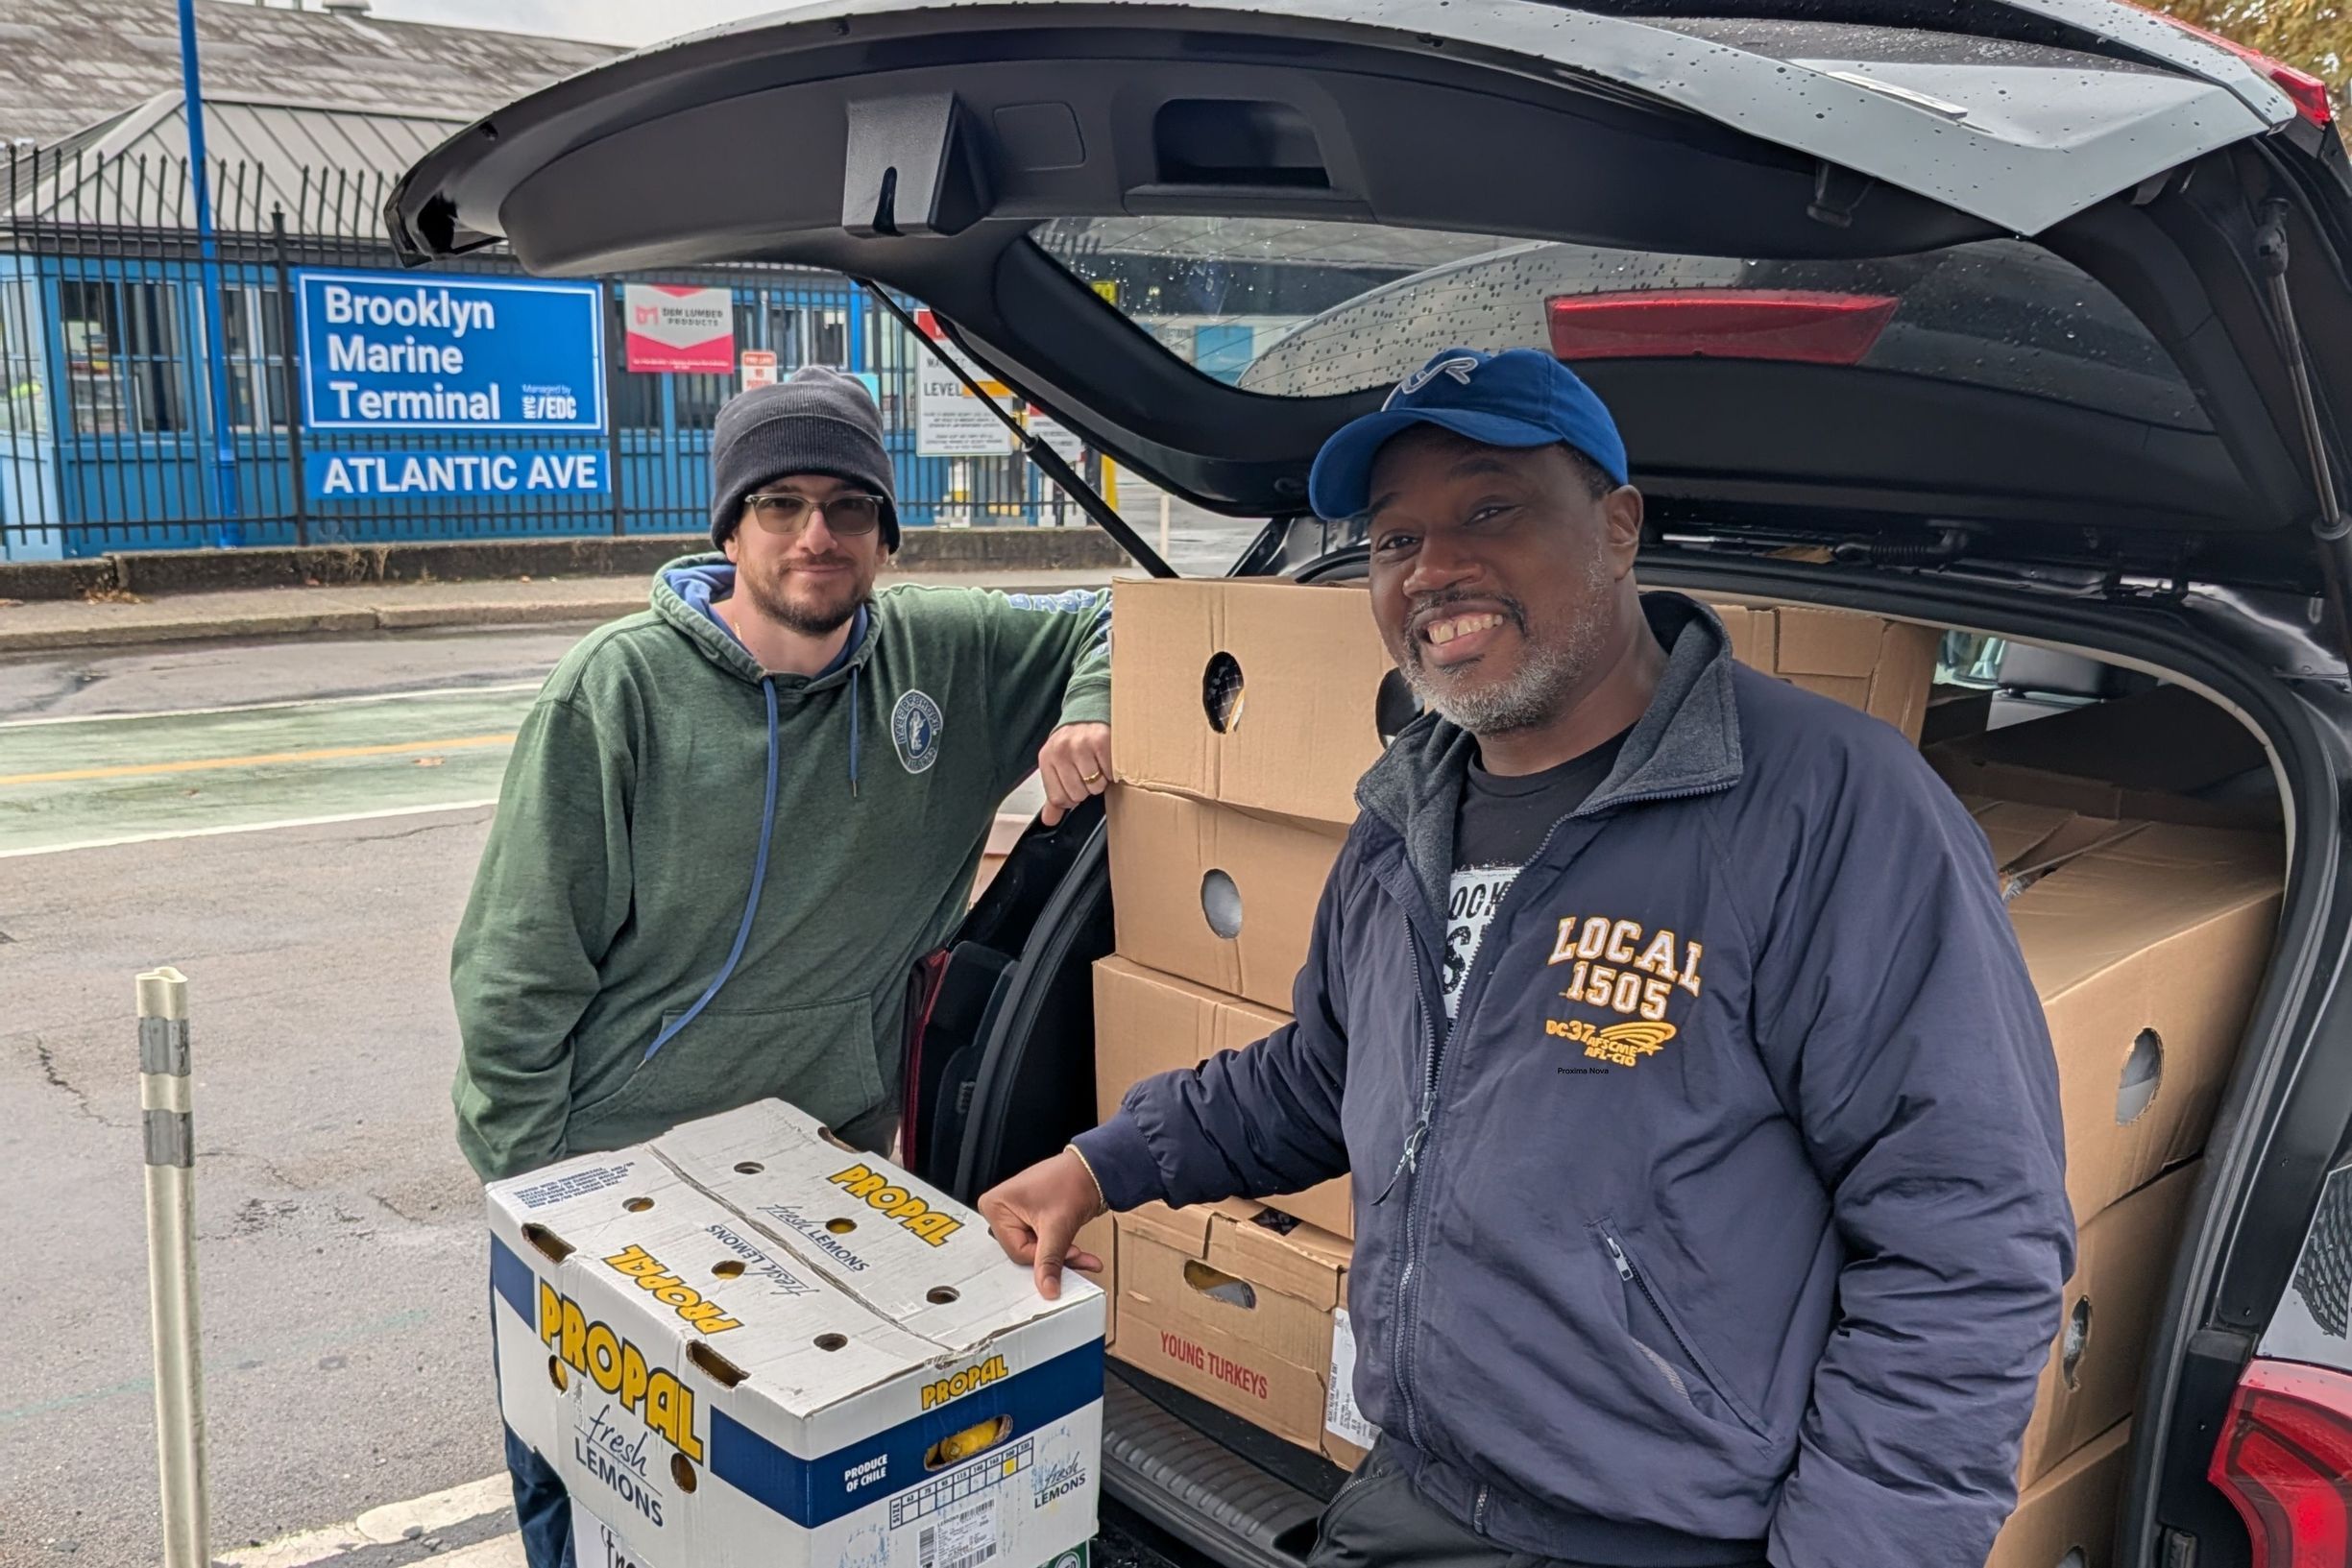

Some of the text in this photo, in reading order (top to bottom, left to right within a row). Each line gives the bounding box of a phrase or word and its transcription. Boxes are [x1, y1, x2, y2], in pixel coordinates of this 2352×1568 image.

[324, 285, 495, 338] Brooklyn
[667, 318, 719, 327] PRODUCTS
[327, 334, 464, 374] Marine
[328, 381, 500, 420] Terminal
[522, 384, 571, 396] Managed by
[522, 395, 537, 420] NYC
[924, 383, 962, 398] LEVEL
[323, 455, 598, 494] ATLANTIC AVE
[1547, 916, 1703, 998] LOCAL
[1565, 961, 1672, 1021] 1505
[1584, 1047, 1637, 1067] AFL-CIO
[1586, 1036, 1637, 1056] AFSCME
[826, 1163, 965, 1248] PROPAL
[706, 1224, 820, 1297] fresh LEMONS
[757, 1204, 870, 1272] fresh LEMONS
[601, 1243, 745, 1336] PROPAL
[540, 1276, 704, 1467] PROPAL
[921, 1354, 1008, 1411] PROPAL
[1161, 1331, 1268, 1400] YOUNG TURKEYS
[587, 1404, 647, 1477] fresh
[575, 1436, 664, 1528] LEMONS
[844, 1454, 888, 1482] PRODUCE
[846, 1466, 886, 1493] OF CHILE
[1034, 1472, 1086, 1509] LEMONS
[1043, 1451, 1079, 1492] fresh
[892, 1502, 901, 1525] SIZE
[956, 1472, 967, 1481] 115
